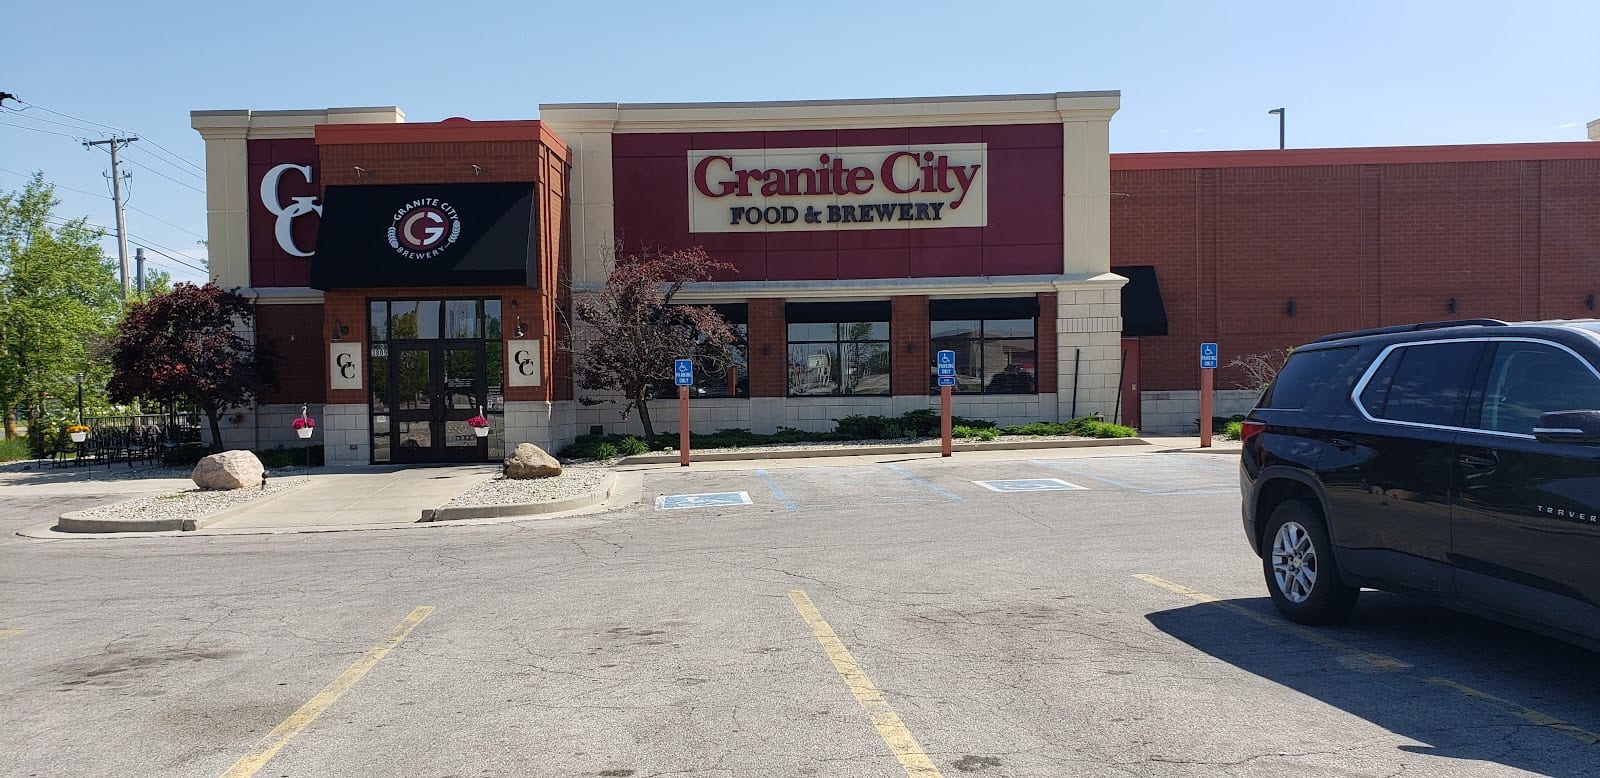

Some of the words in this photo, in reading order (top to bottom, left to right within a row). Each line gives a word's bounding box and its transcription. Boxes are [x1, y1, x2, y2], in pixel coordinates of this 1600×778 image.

[694, 153, 875, 197] Granite
[880, 151, 981, 210] City
[393, 198, 439, 221] GRANITE
[440, 202, 459, 220] CITY
[729, 205, 799, 225] FOOD
[804, 205, 822, 224] &
[826, 201, 944, 224] BREWERY
[396, 246, 445, 260] BREWERY
[1537, 505, 1597, 522] TRAVER
